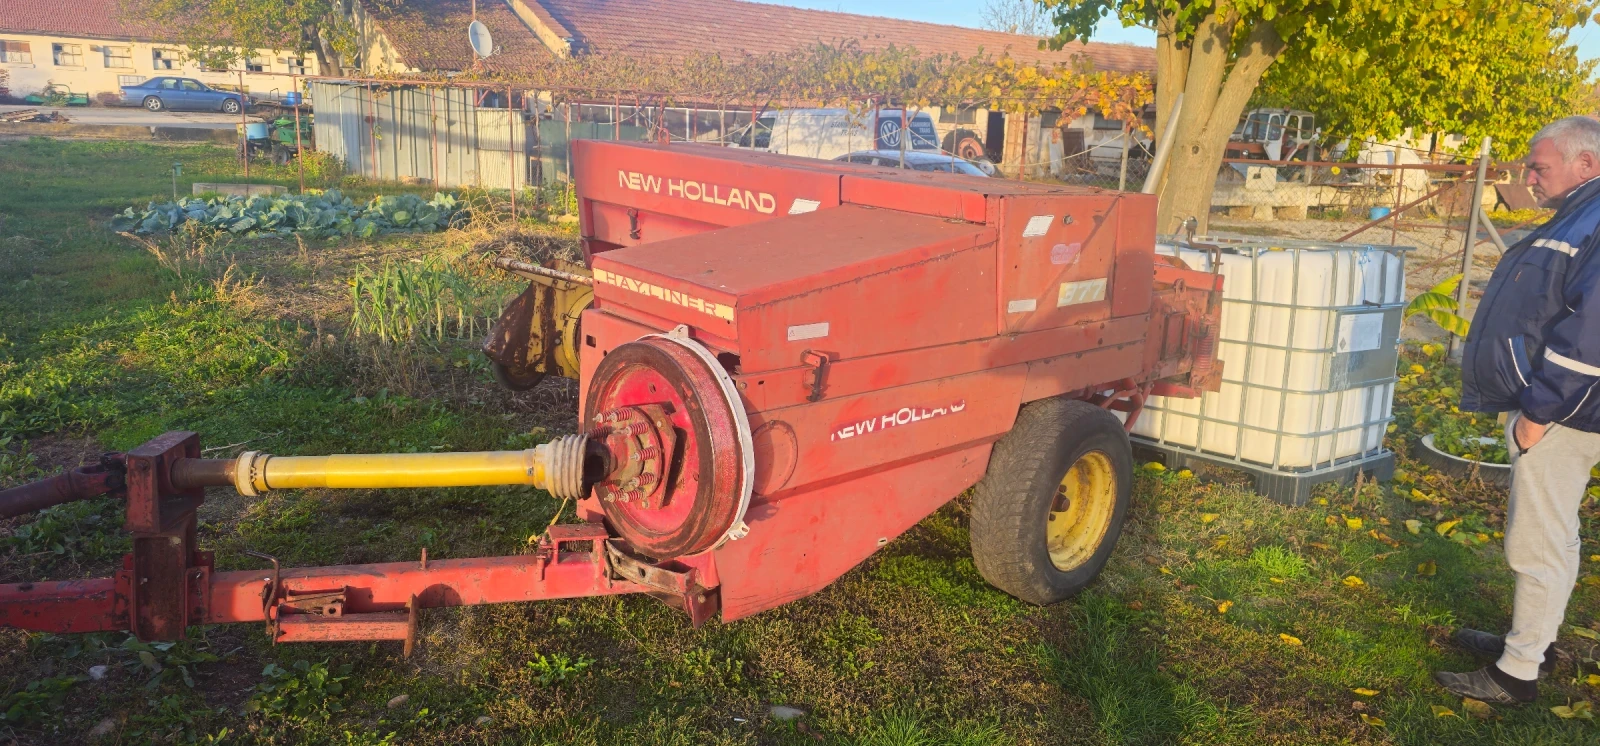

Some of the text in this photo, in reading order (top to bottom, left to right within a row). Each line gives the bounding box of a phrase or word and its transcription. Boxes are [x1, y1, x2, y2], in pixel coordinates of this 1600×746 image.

[618, 170, 662, 194] NEW
[668, 178, 776, 214] HOLLAND
[1060, 281, 1104, 303] 377
